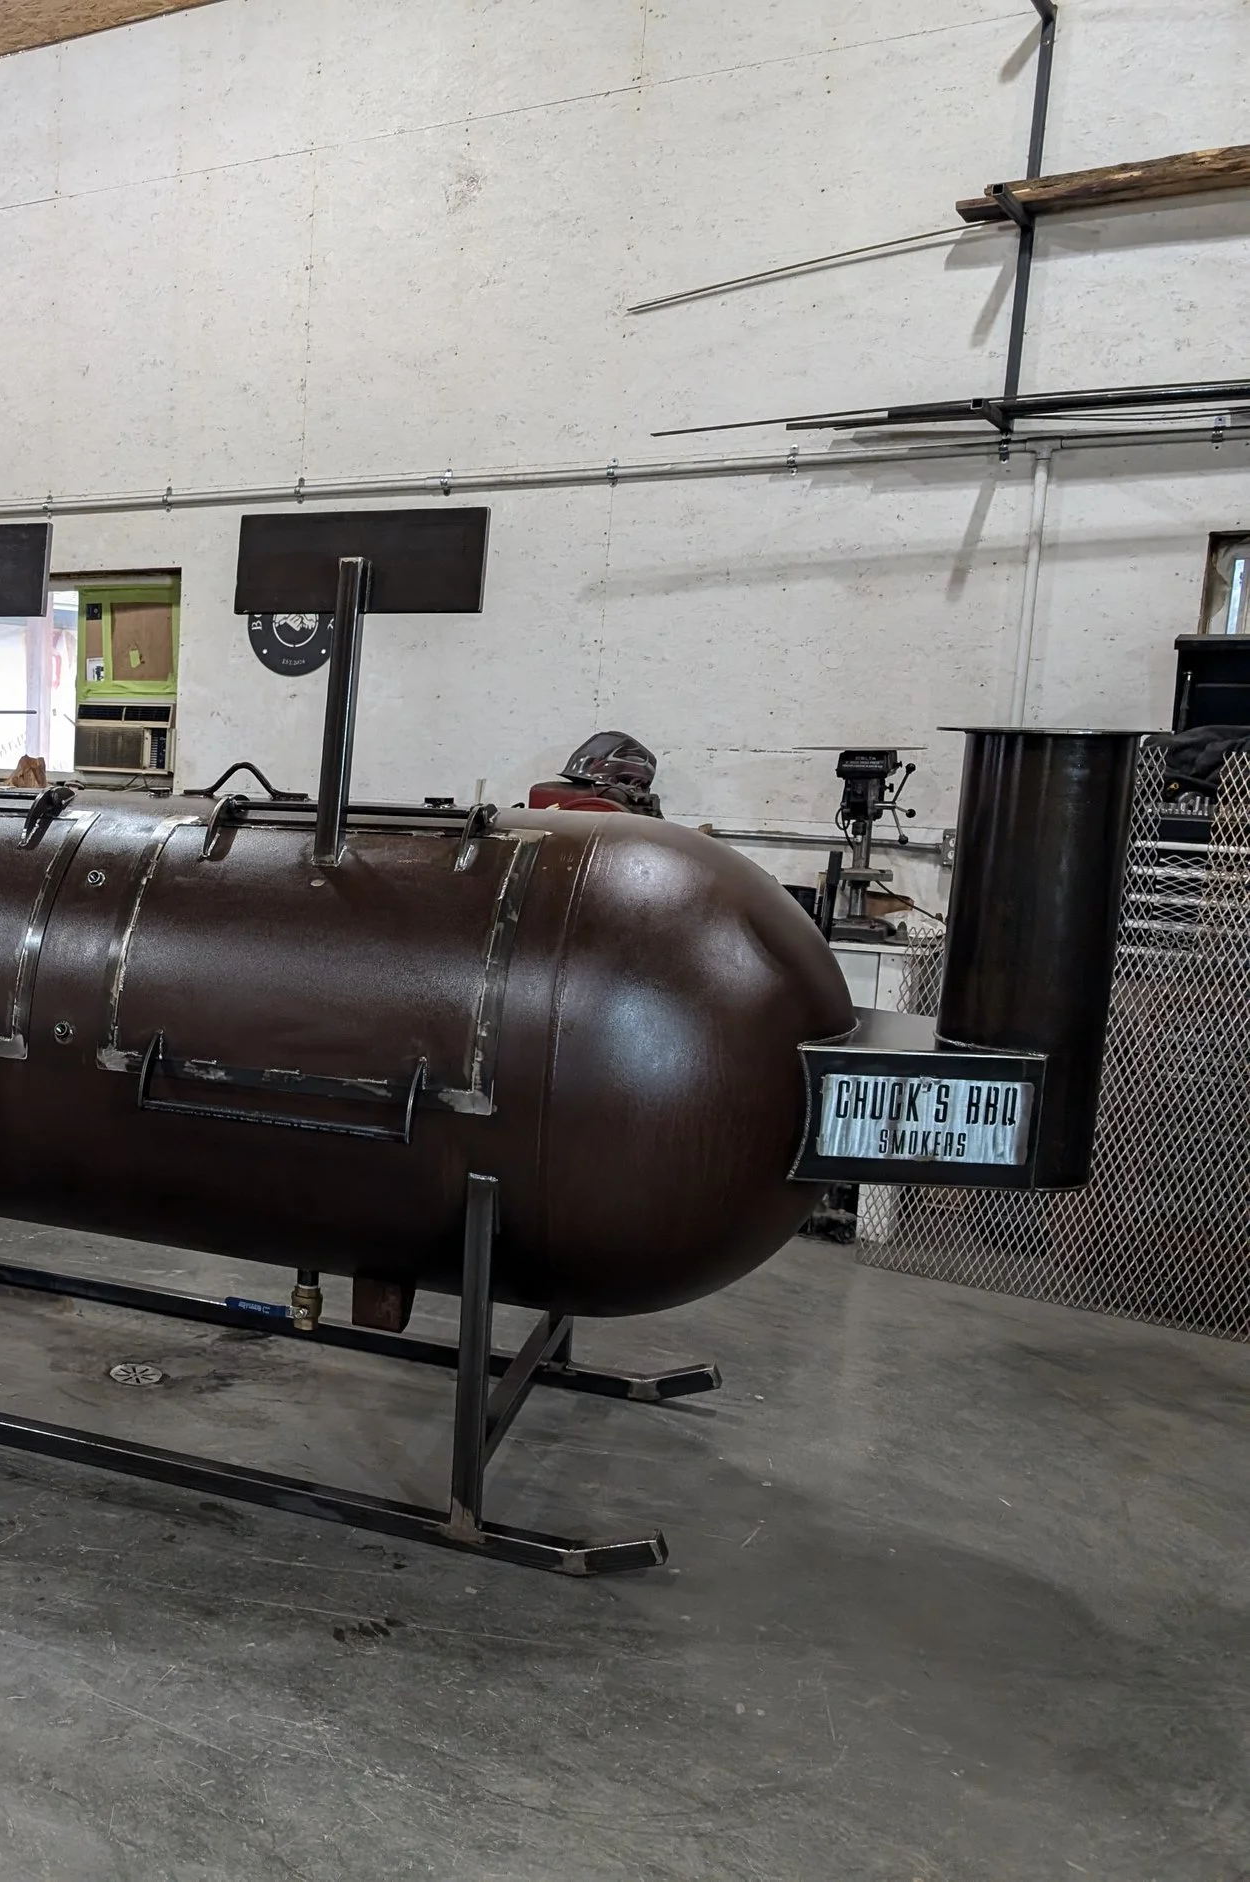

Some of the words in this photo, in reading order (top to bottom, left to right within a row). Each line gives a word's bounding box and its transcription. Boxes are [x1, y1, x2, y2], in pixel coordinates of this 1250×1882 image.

[835, 1080, 950, 1123] CHUCK'S
[965, 1085, 1018, 1126] BBQ
[878, 1129, 967, 1157] SMOKERS
